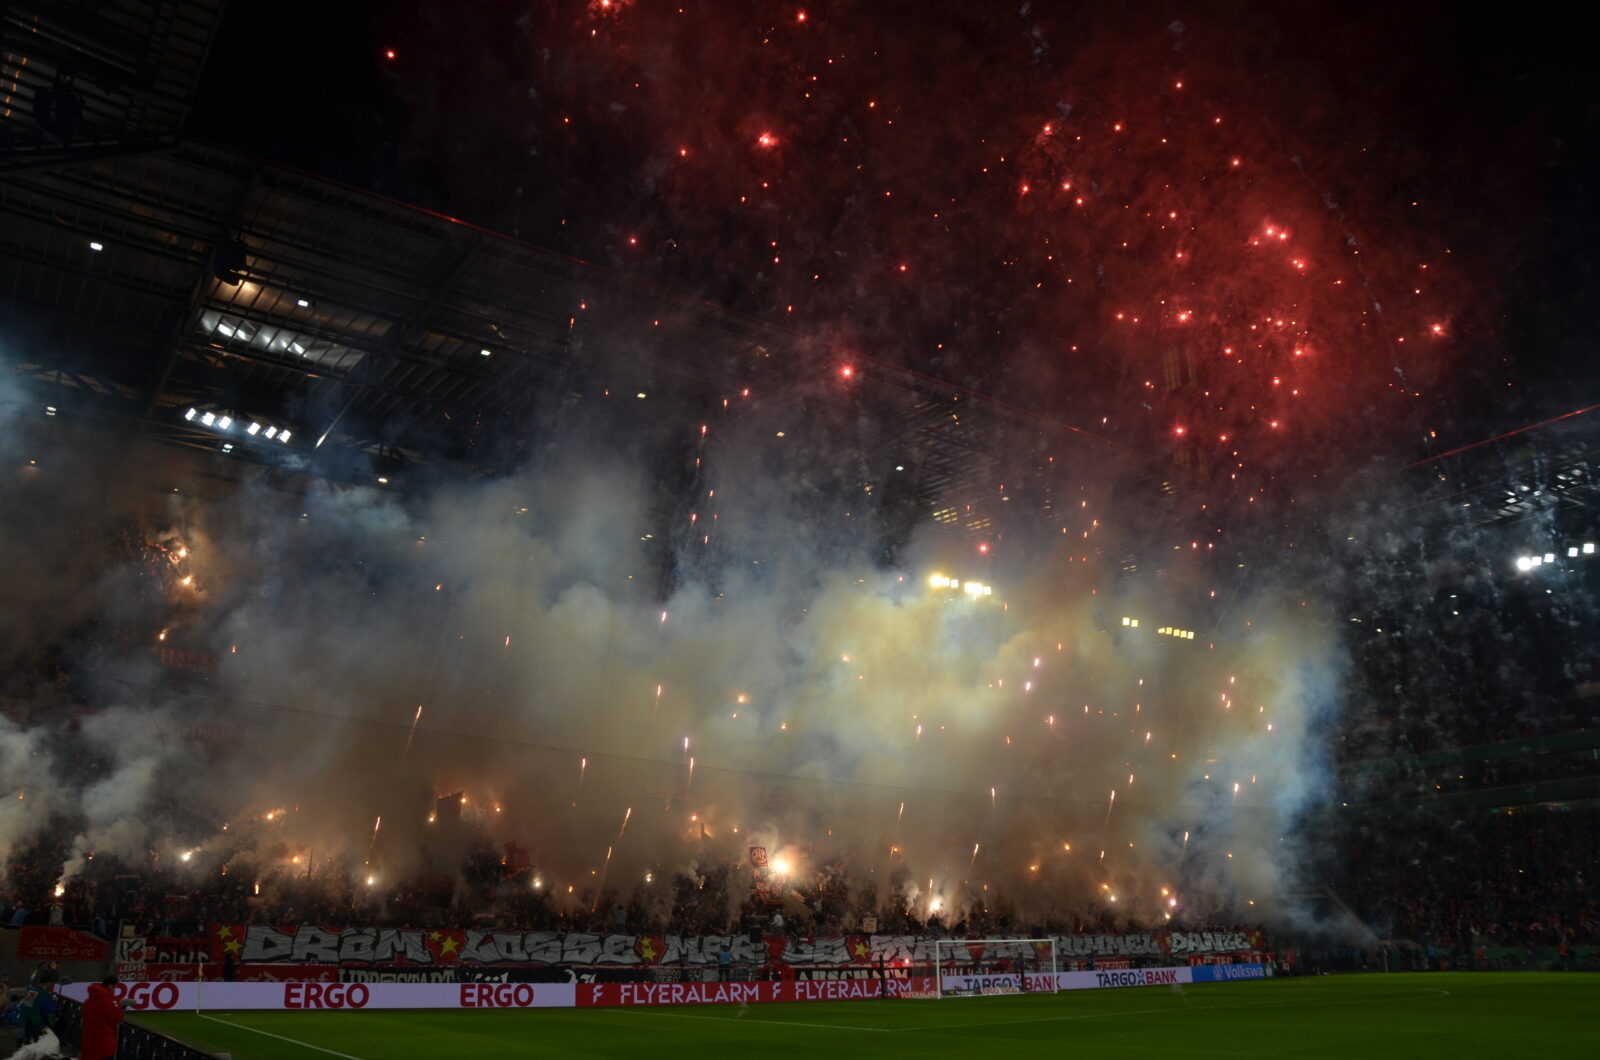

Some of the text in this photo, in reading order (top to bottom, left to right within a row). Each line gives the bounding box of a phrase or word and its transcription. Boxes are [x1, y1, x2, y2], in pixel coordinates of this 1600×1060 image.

[459, 929, 643, 965] LOSSE
[1170, 931, 1251, 954] DANZE
[284, 983, 370, 1009] ERGO
[460, 983, 534, 1008] ERGO
[620, 983, 760, 1005] FLYERALARM
[794, 977, 912, 1001] FLYERALARM
